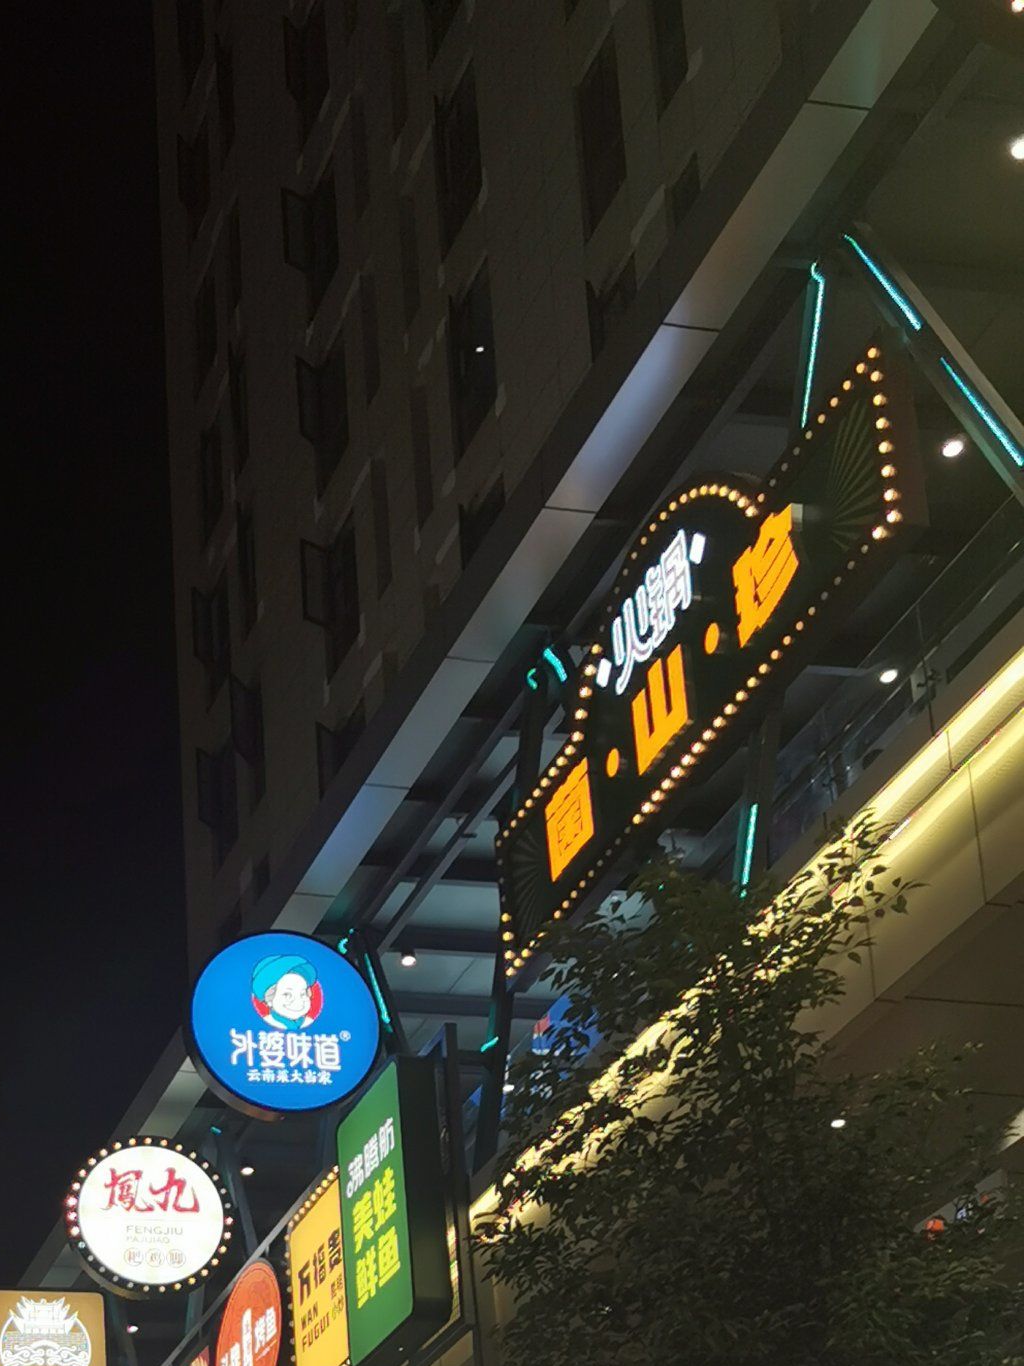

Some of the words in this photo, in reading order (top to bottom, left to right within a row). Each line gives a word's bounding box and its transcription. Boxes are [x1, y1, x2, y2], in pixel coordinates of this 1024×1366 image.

[611, 529, 692, 695] 火鍋
[230, 1028, 341, 1070] 外婆味道
[126, 1225, 183, 1236] FENGJIU
[301, 1313, 331, 1352] FUGUI
